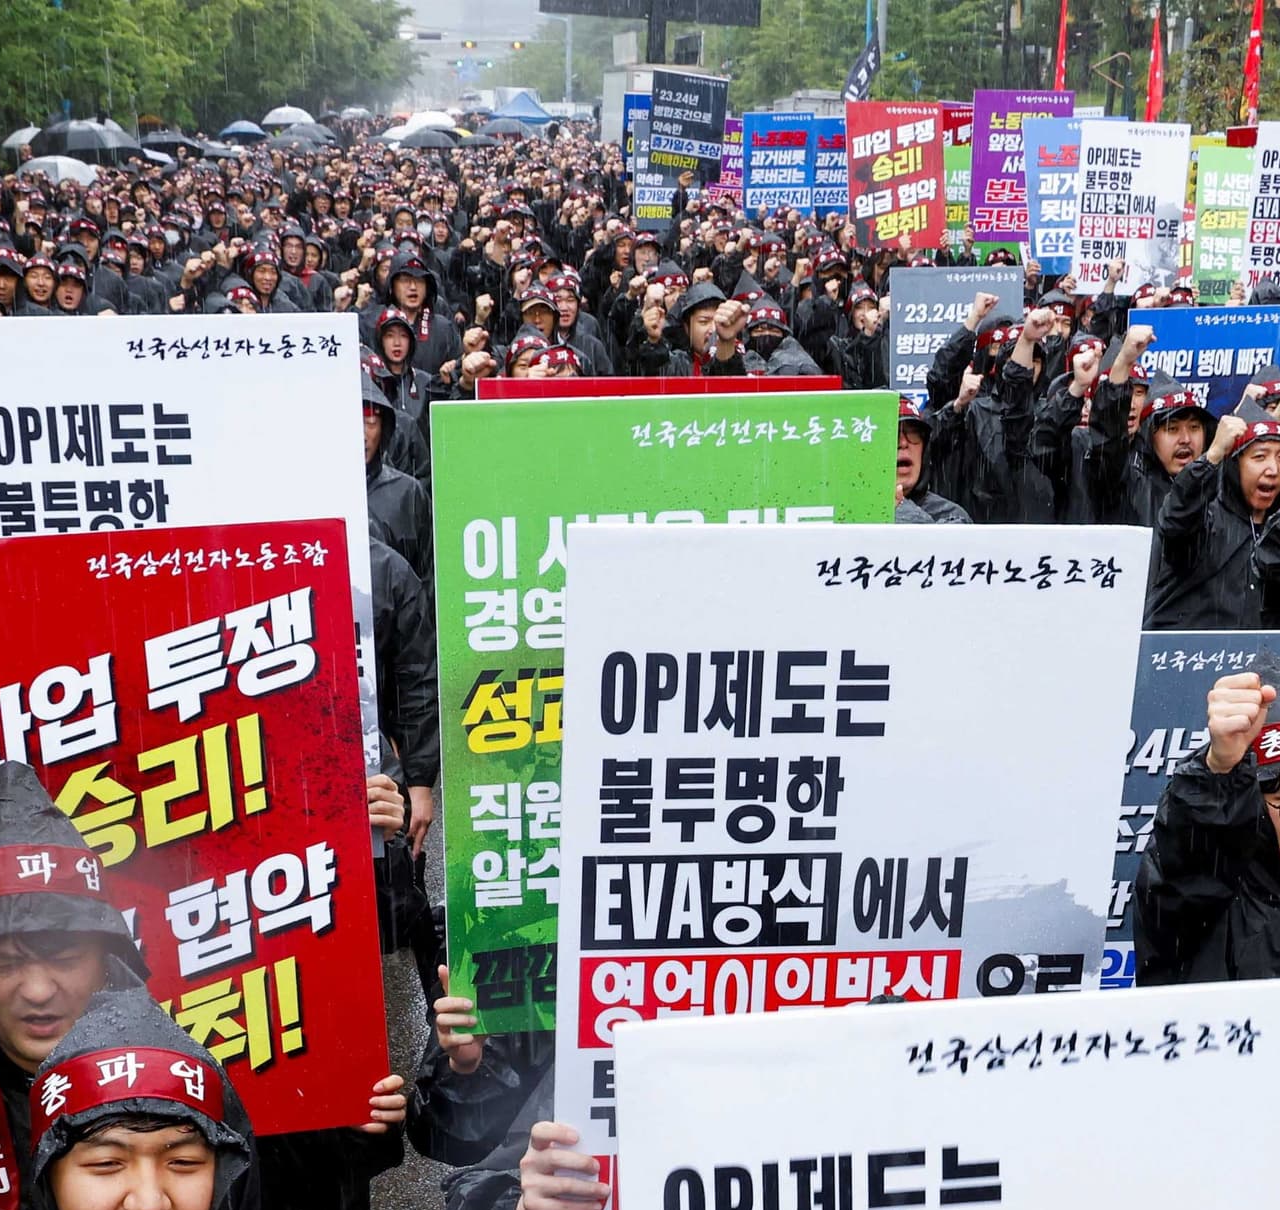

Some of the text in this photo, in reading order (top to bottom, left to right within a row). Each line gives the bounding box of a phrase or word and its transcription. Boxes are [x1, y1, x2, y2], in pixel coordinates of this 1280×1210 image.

[852, 129, 891, 159] 파업
[896, 119, 935, 147] 투쟁
[1087, 147, 1142, 168] OPI제도는
[871, 146, 923, 183] 승리!
[1086, 171, 1132, 191] 불투명한
[750, 188, 810, 206] 삼성전자!
[855, 178, 937, 219] 임금 협약
[1082, 193, 1155, 214] EVA방식 에서
[875, 205, 928, 241] 쟁취!
[1081, 217, 1179, 238] 영업이익방식 으로
[1080, 240, 1126, 260] 투명하게
[126, 334, 342, 359] 전국삼성전자노동조합
[1140, 347, 1273, 378] 연예인 병에 빠진
[631, 416, 878, 448] 전국삼성전자노동조합
[86, 541, 328, 579] 전국삼성전자노동조합
[817, 556, 1122, 588] 전국삼성전자노동조합
[144, 587, 318, 723] 투쟁
[600, 649, 890, 738] OPI제도는
[53, 715, 268, 867] 승리!
[599, 756, 845, 844] 불투명한
[165, 842, 336, 977] 협약
[594, 857, 969, 946] EVA방식 에서
[907, 1018, 1261, 1074] 전국삼성전자노동조합
[40, 1052, 206, 1116] 총파업
